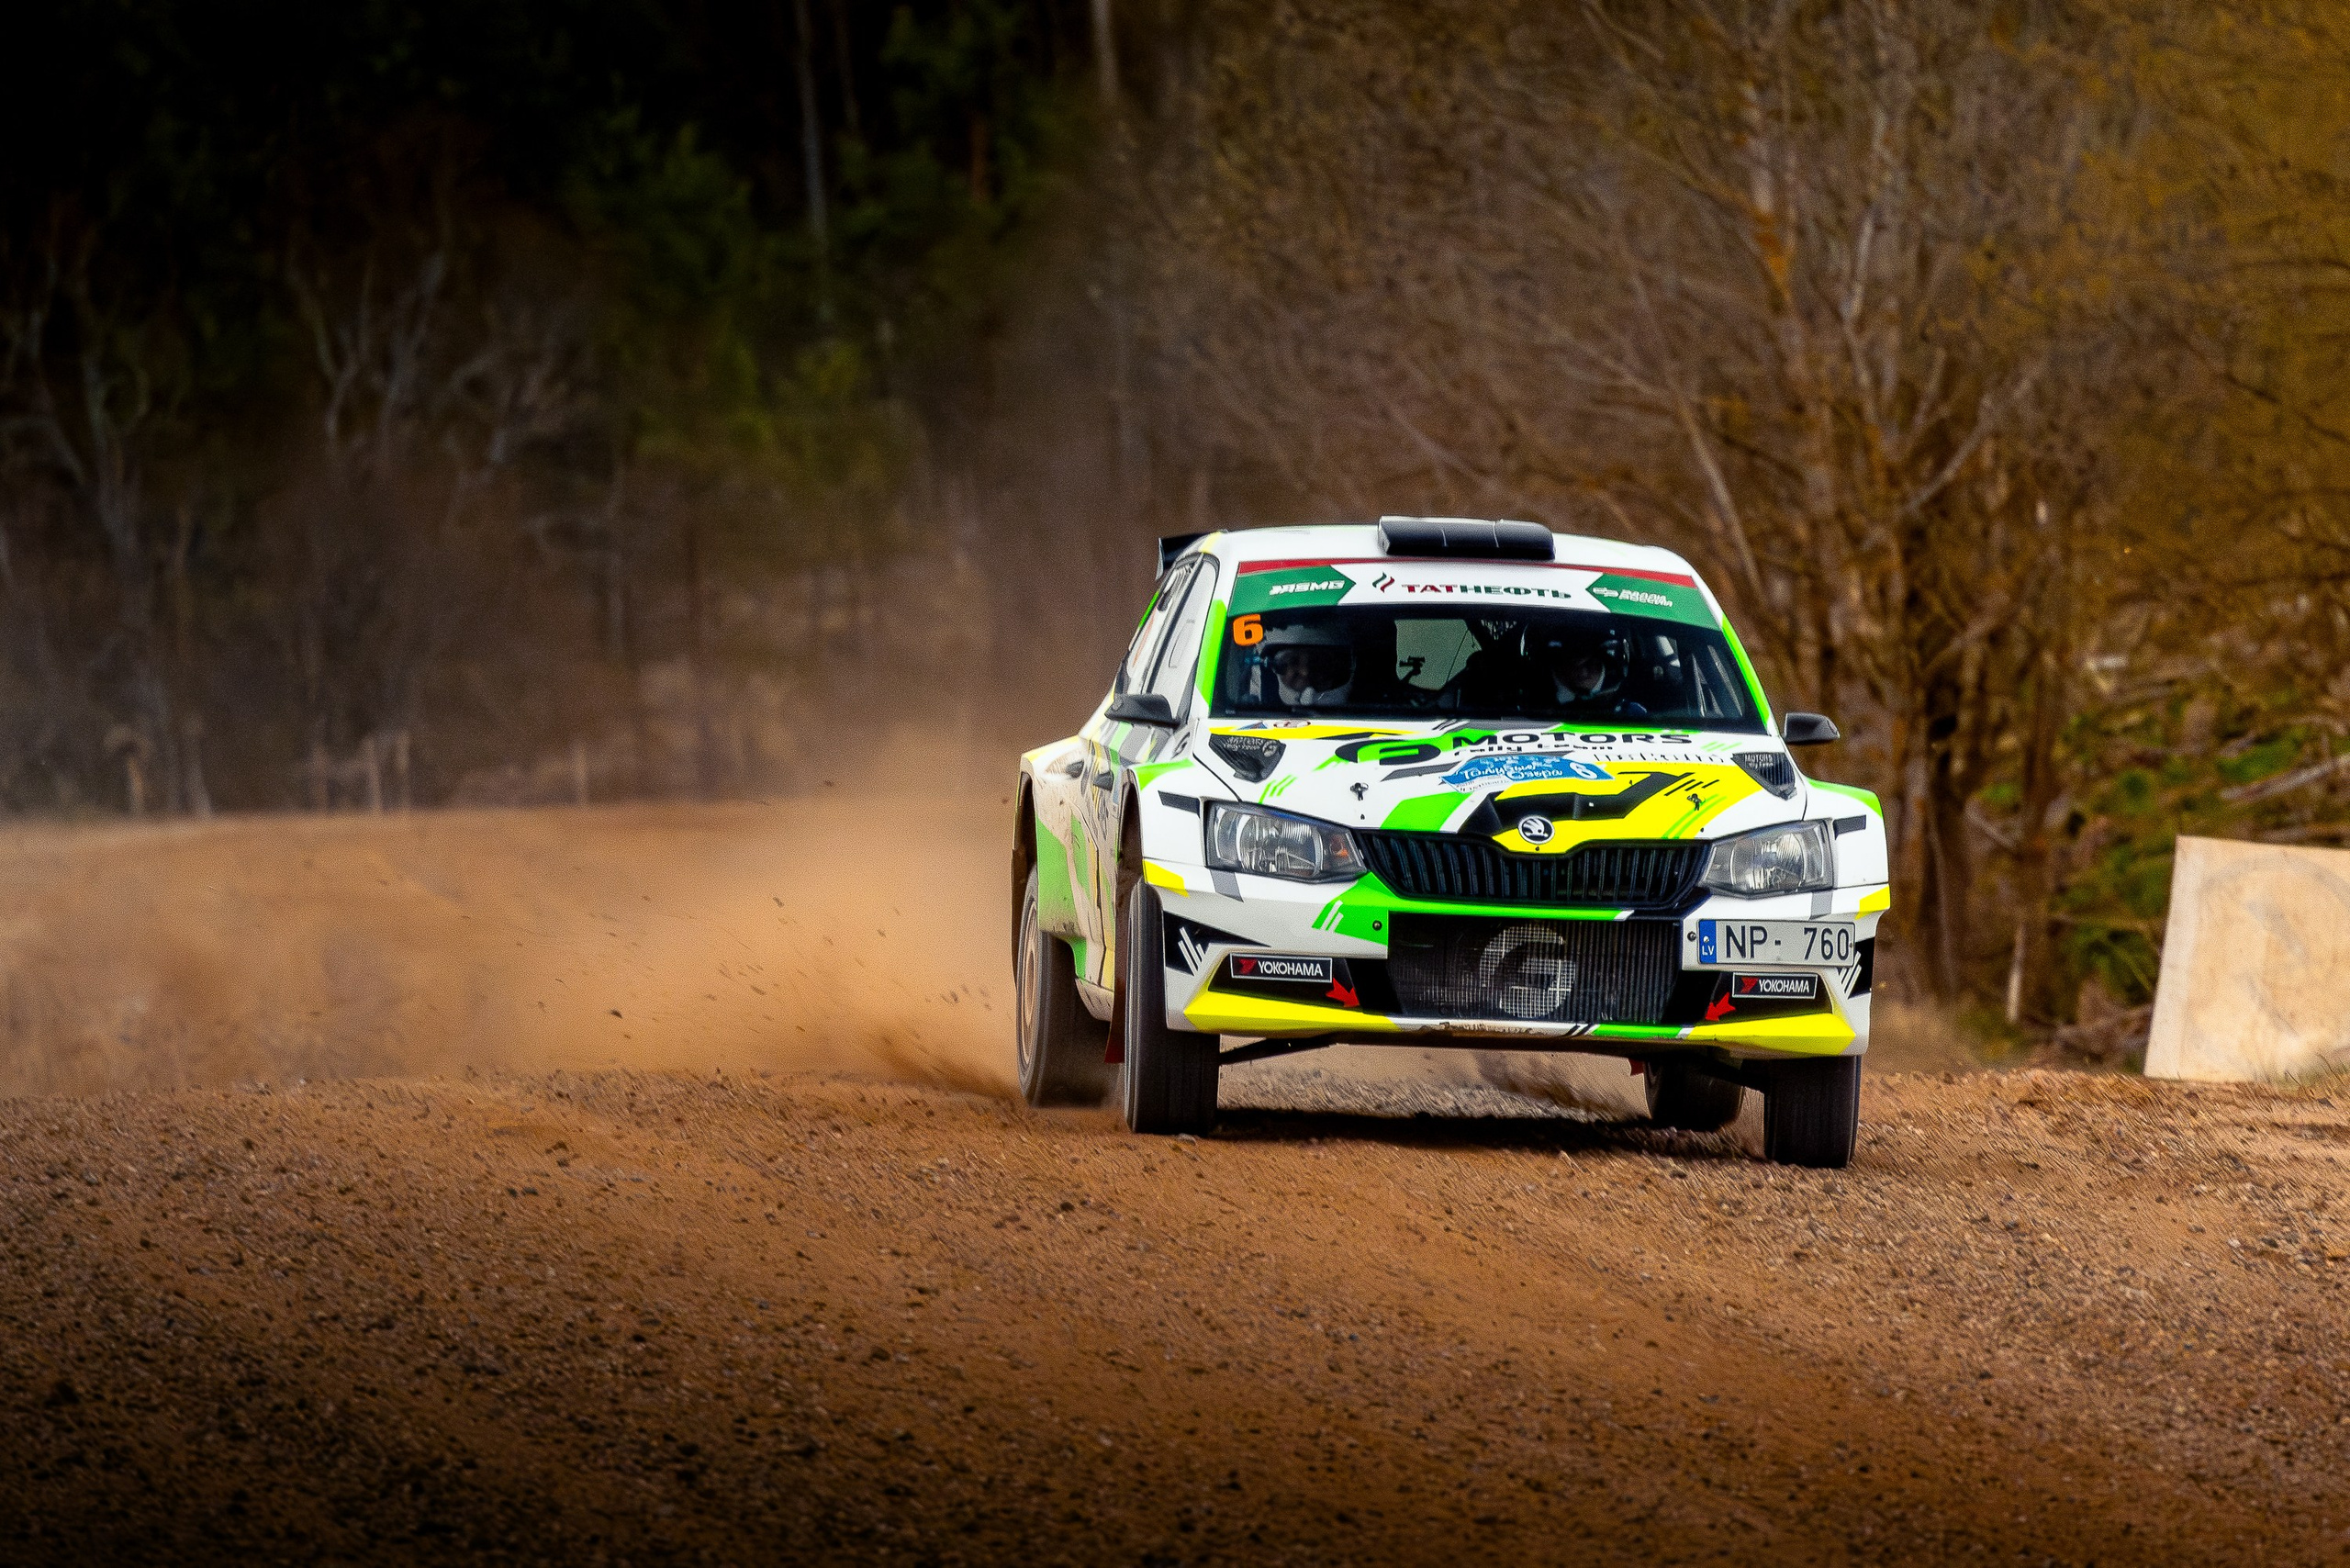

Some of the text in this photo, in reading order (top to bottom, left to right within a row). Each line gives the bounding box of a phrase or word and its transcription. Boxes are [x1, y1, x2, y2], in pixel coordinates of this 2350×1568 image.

[1401, 584, 1572, 599] ТАТНЕФТЬ
[1233, 613, 1264, 646] 6
[1452, 732, 1693, 750] MOTORS
[1701, 945, 1715, 957] LV
[1803, 926, 1850, 961] 760
[1258, 960, 1324, 978] YOKOHAMA
[1758, 979, 1810, 994] YOKOHAMA
